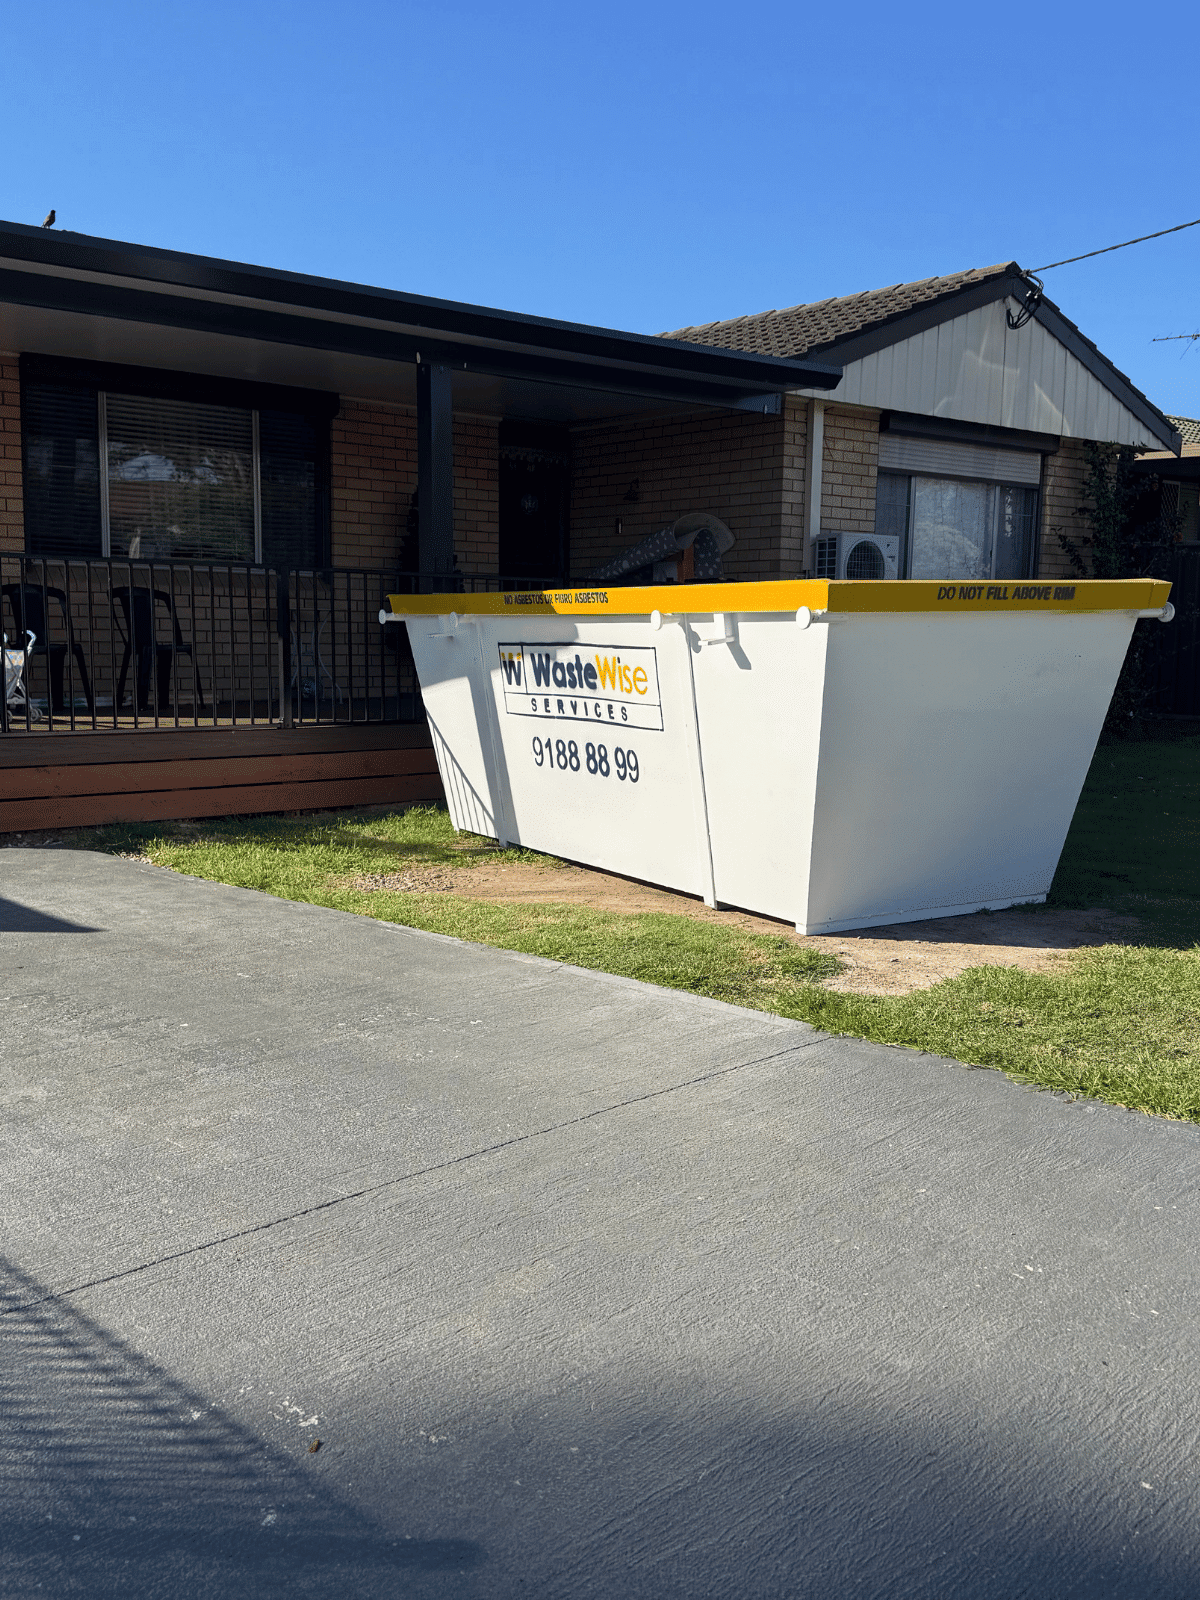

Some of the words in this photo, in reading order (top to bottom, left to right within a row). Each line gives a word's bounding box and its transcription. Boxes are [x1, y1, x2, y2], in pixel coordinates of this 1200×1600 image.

[504, 594, 513, 605] NO
[514, 594, 543, 604] ASBESTOS
[574, 591, 609, 604] ASBESTOS
[937, 586, 956, 600] DO
[958, 586, 984, 600] NOT
[986, 586, 1009, 600] FILL
[1012, 586, 1051, 600] ABOVE
[1052, 586, 1076, 600] RIM
[530, 652, 648, 695] WasteWise
[531, 698, 628, 721] SERVICES
[532, 736, 580, 772] 9188
[585, 742, 610, 777] 88
[614, 747, 640, 783] 99
